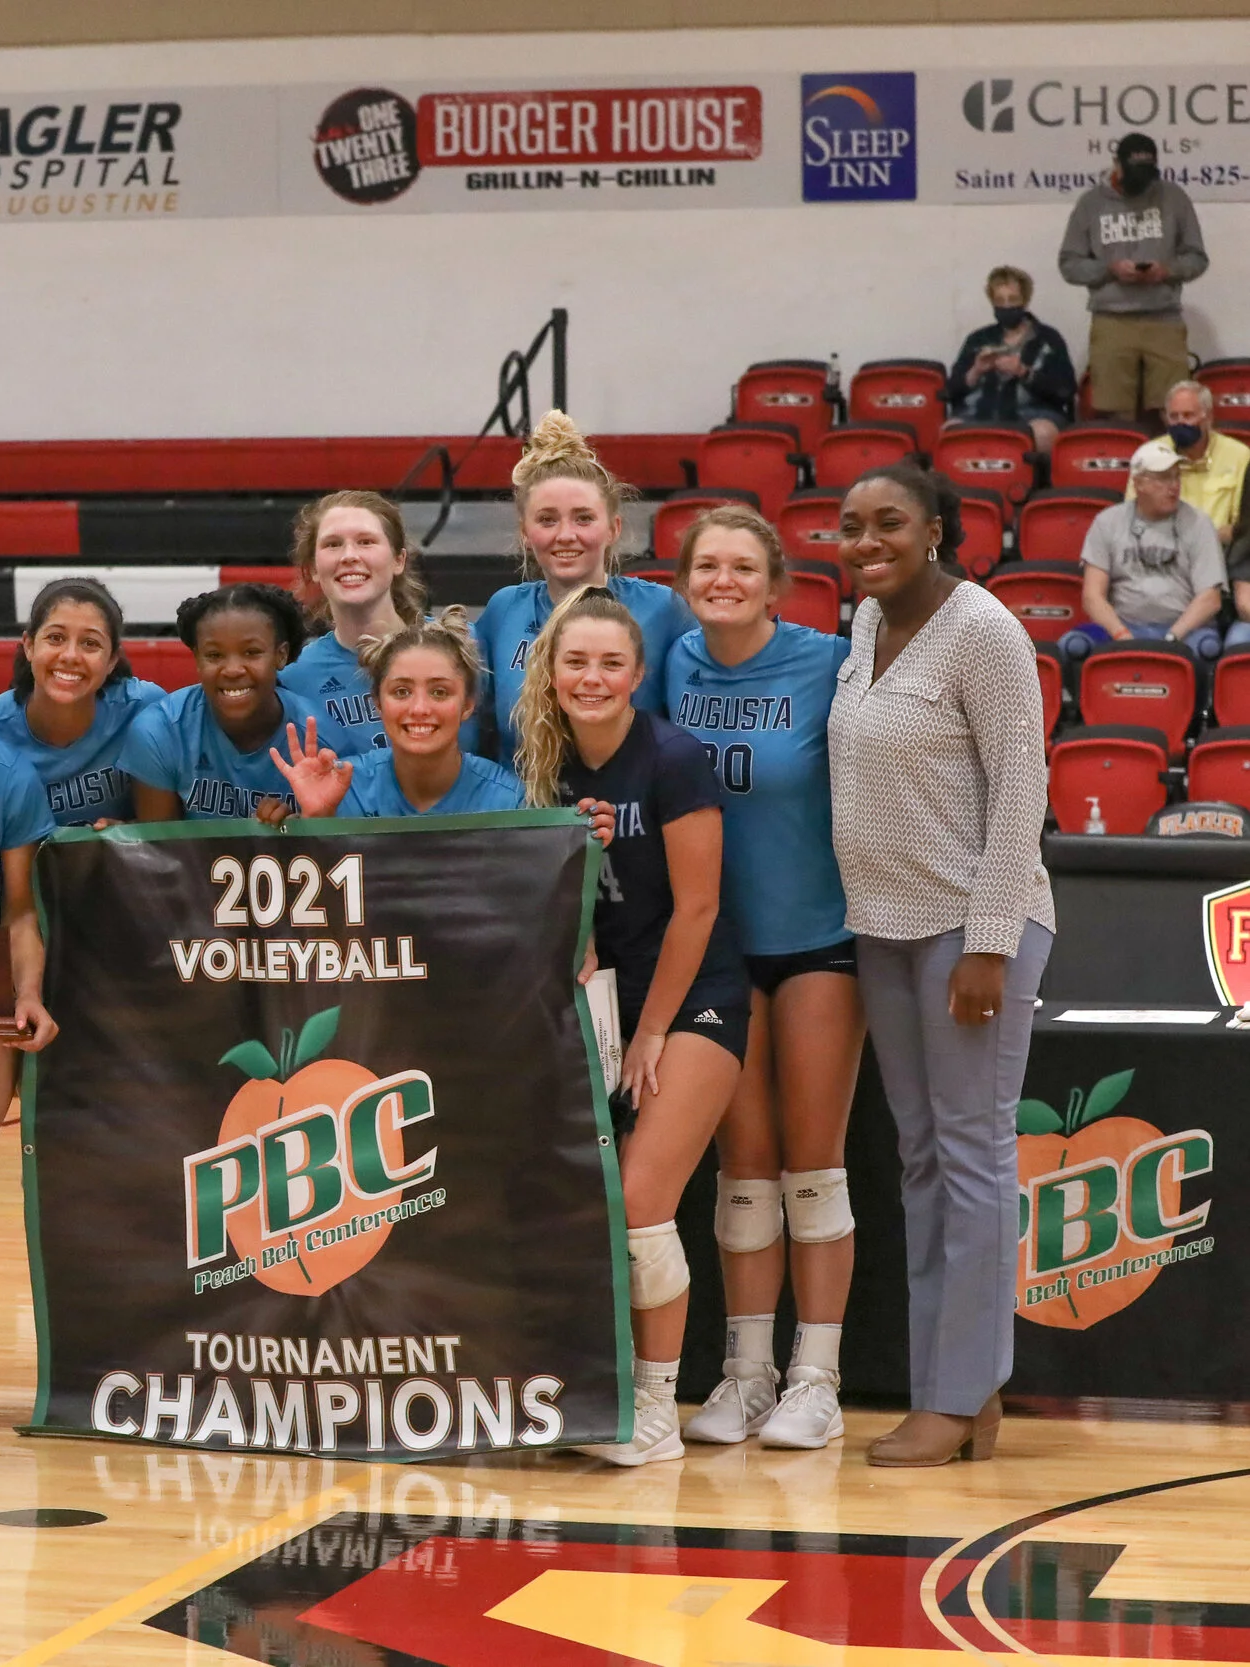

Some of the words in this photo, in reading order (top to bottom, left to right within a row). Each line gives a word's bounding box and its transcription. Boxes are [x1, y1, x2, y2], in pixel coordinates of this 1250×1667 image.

[357, 98, 400, 131] ONE
[1028, 80, 1250, 128] CHOICE
[316, 126, 404, 170] TWENTY
[434, 99, 598, 158] BURGER
[612, 97, 748, 155] HOUSE
[345, 156, 411, 190] THREE
[466, 168, 716, 192] GRILLIN-N-CHILLIN
[828, 161, 892, 189] INN
[955, 168, 1015, 190] Saint
[1024, 168, 1097, 195] Augus
[675, 691, 791, 731] AUGUSTA
[1158, 811, 1243, 838] FLAGLER
[209, 853, 366, 929] 2021
[169, 937, 428, 983] VOLLEYBALL
[693, 1016, 723, 1025] adidas
[183, 1069, 439, 1269] PBC
[1017, 1129, 1214, 1280] BC
[194, 1256, 258, 1295] Peach
[262, 1239, 300, 1270] Belt
[305, 1187, 447, 1252] Conference
[1026, 1276, 1071, 1306] Belt
[1077, 1236, 1215, 1290] Conference
[185, 1332, 462, 1377] TOURNAMENT
[91, 1370, 565, 1453] CHAMPIONS
